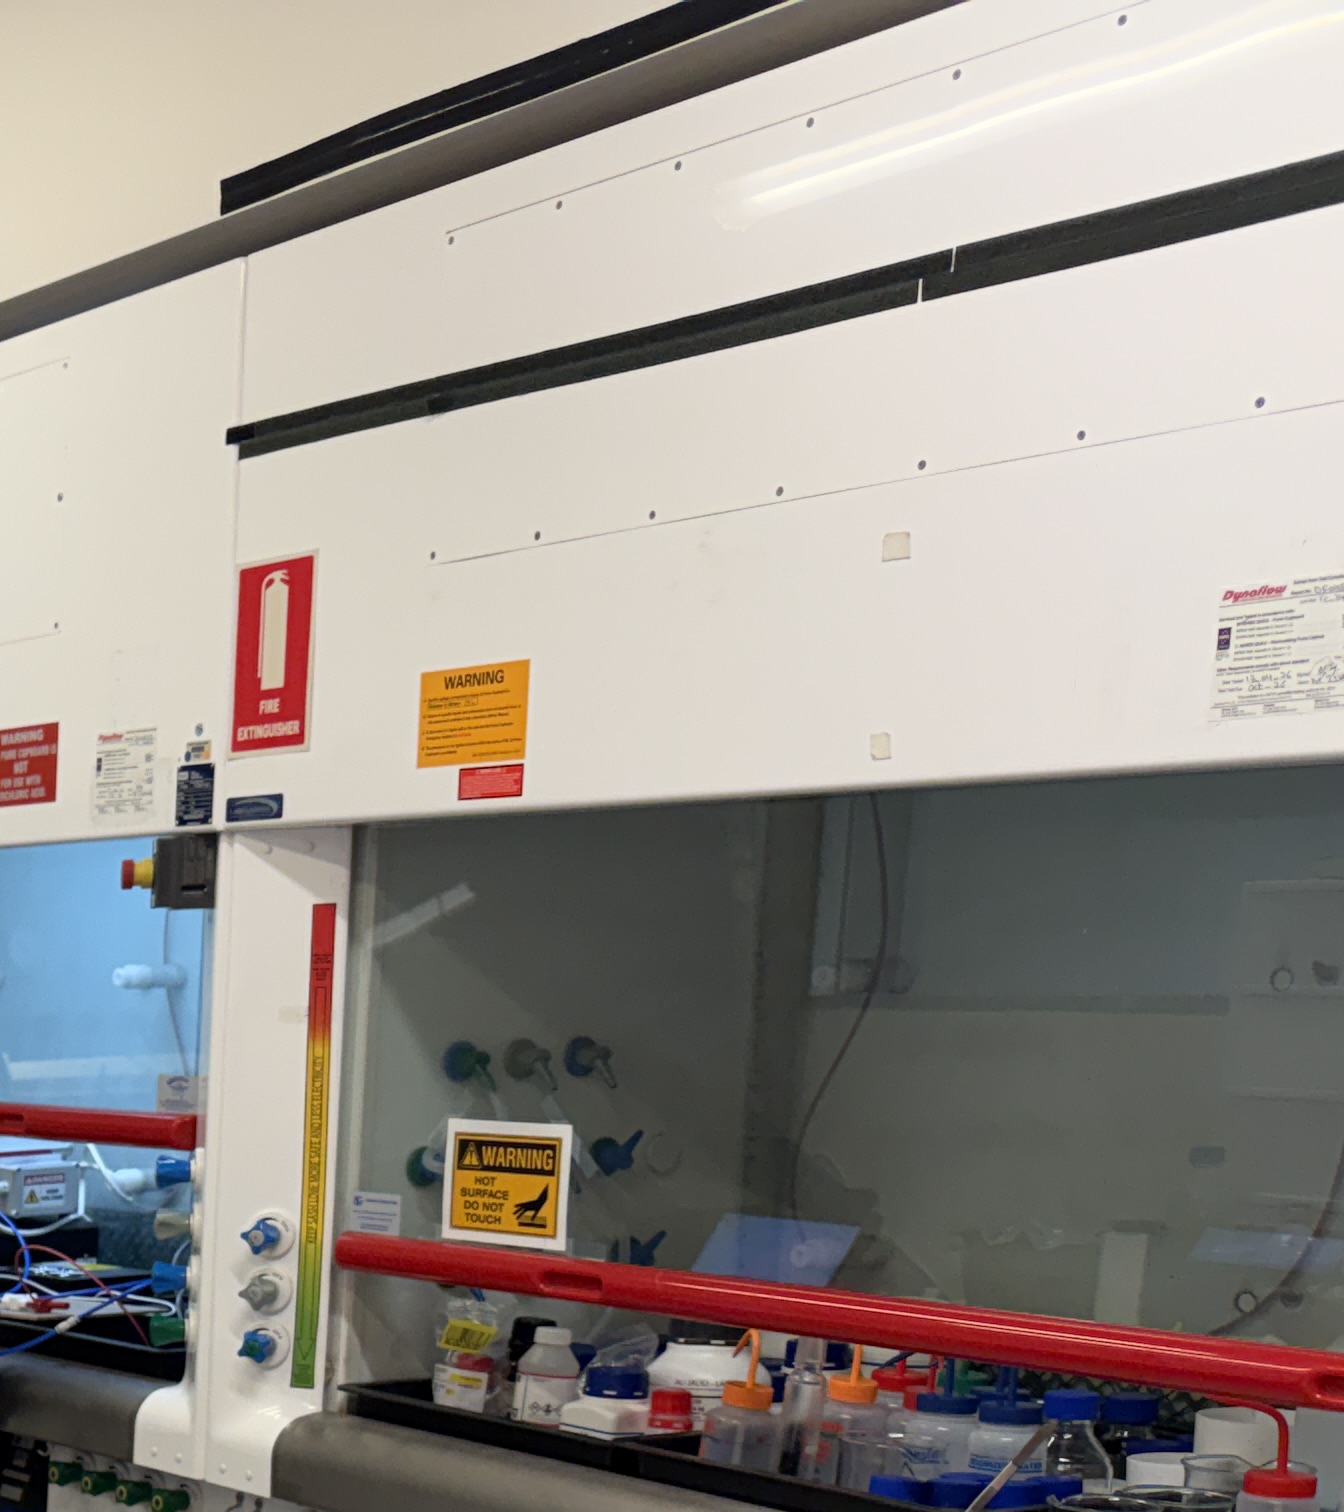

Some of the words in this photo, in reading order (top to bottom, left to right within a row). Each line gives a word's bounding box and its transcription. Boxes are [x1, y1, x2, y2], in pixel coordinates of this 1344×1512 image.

[444, 669, 505, 690] WARNING
[259, 698, 281, 715] FIRE
[0, 729, 44, 746] WARNING
[236, 720, 300, 742] EXTINGUISHER
[481, 1145, 553, 1171] WARNING
[474, 1176, 497, 1187] HOT
[460, 1187, 509, 1201] SURFACE
[463, 1200, 480, 1210] DO
[482, 1202, 504, 1212] NOT
[464, 1212, 501, 1225] TOUCH
